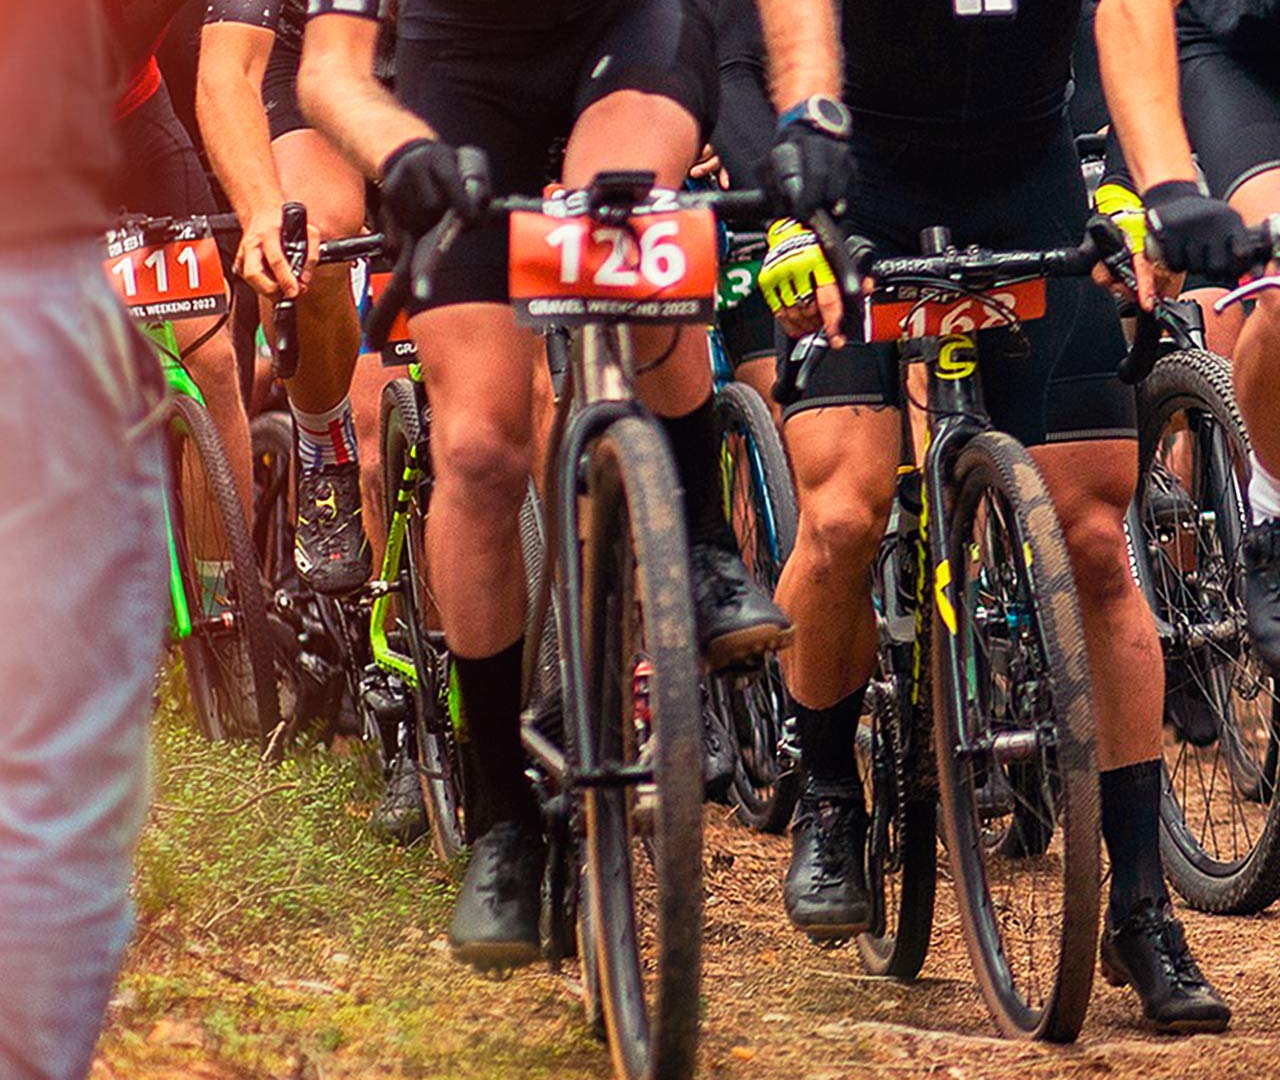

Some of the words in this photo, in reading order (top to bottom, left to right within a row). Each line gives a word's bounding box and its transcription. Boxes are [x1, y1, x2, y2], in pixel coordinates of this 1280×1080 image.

[112, 246, 200, 296] 111
[545, 221, 687, 287] 126
[146, 301, 191, 315] WEEKEND
[192, 297, 216, 311] 2023
[528, 299, 585, 316] GRAVEL
[660, 300, 699, 316] 2023
